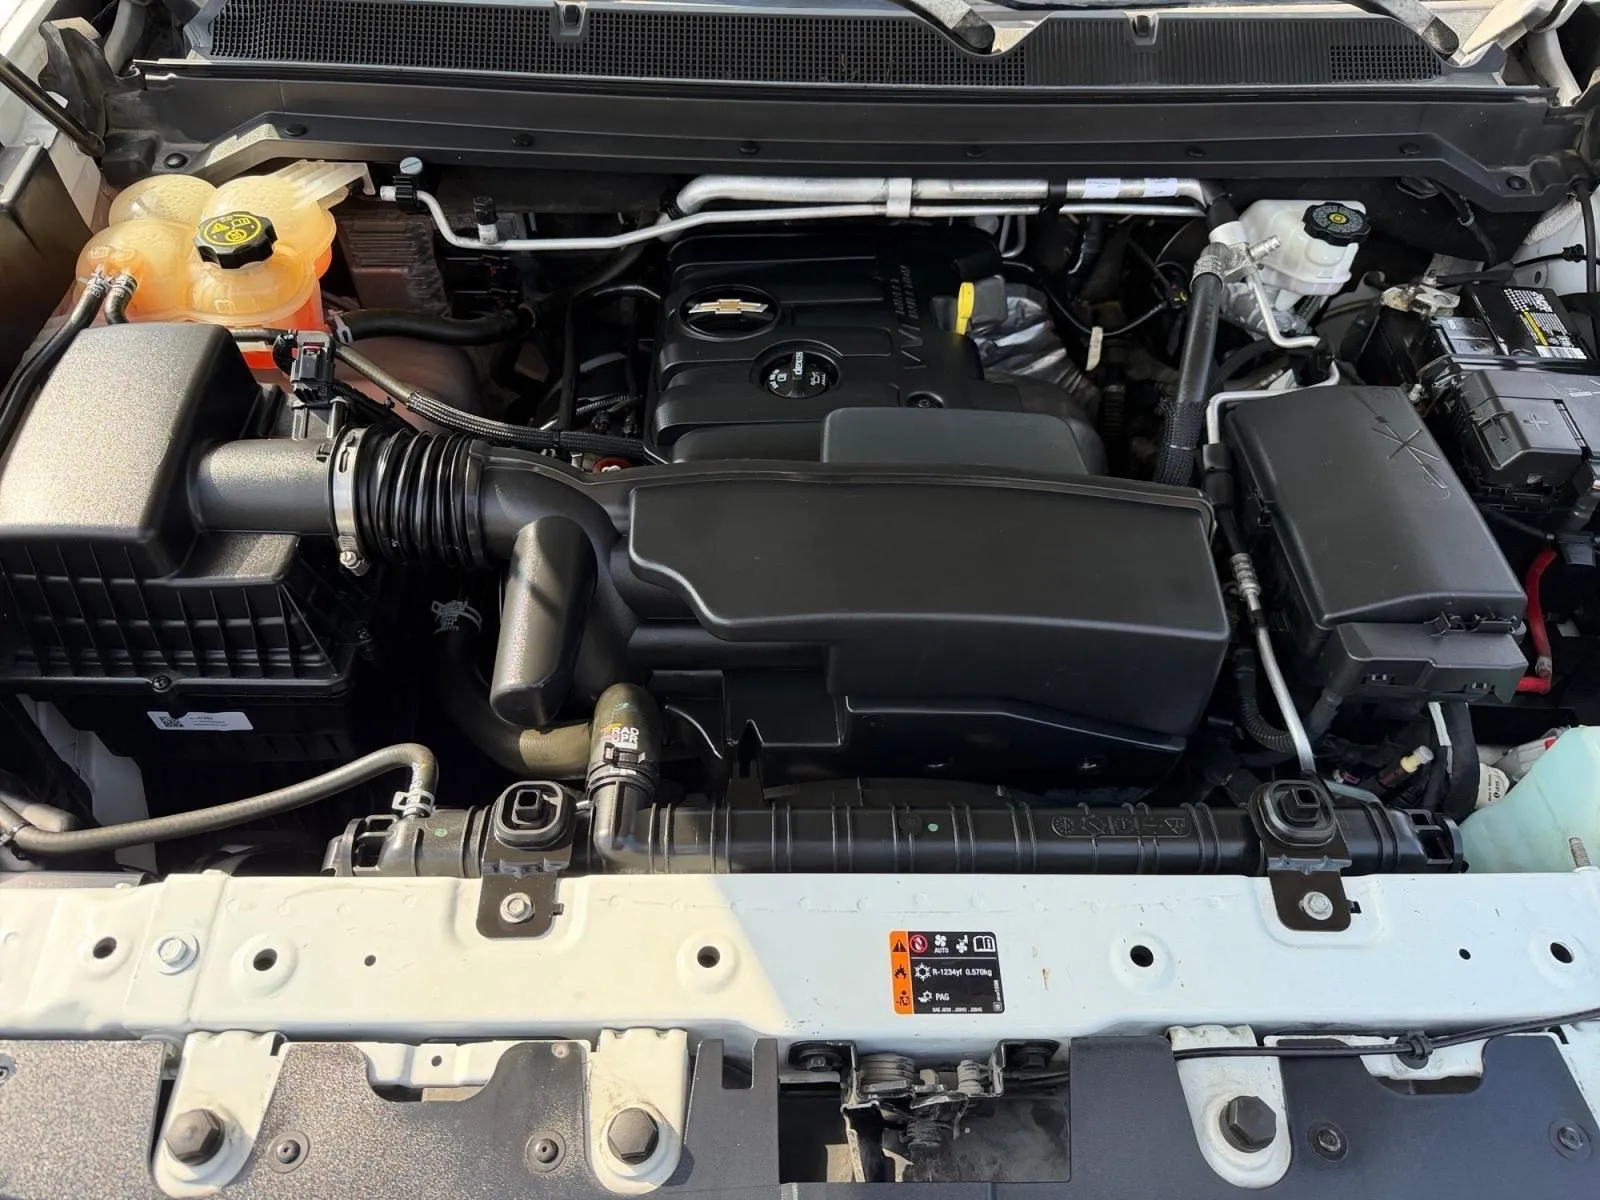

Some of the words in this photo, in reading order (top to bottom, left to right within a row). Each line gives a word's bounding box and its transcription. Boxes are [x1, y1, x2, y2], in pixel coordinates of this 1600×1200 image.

[793, 351, 804, 375] dexos
[612, 726, 640, 736] RAD
[932, 968, 963, 977] R-1234yf
[965, 968, 993, 977] 0.570kg
[935, 992, 950, 1001] PAG
